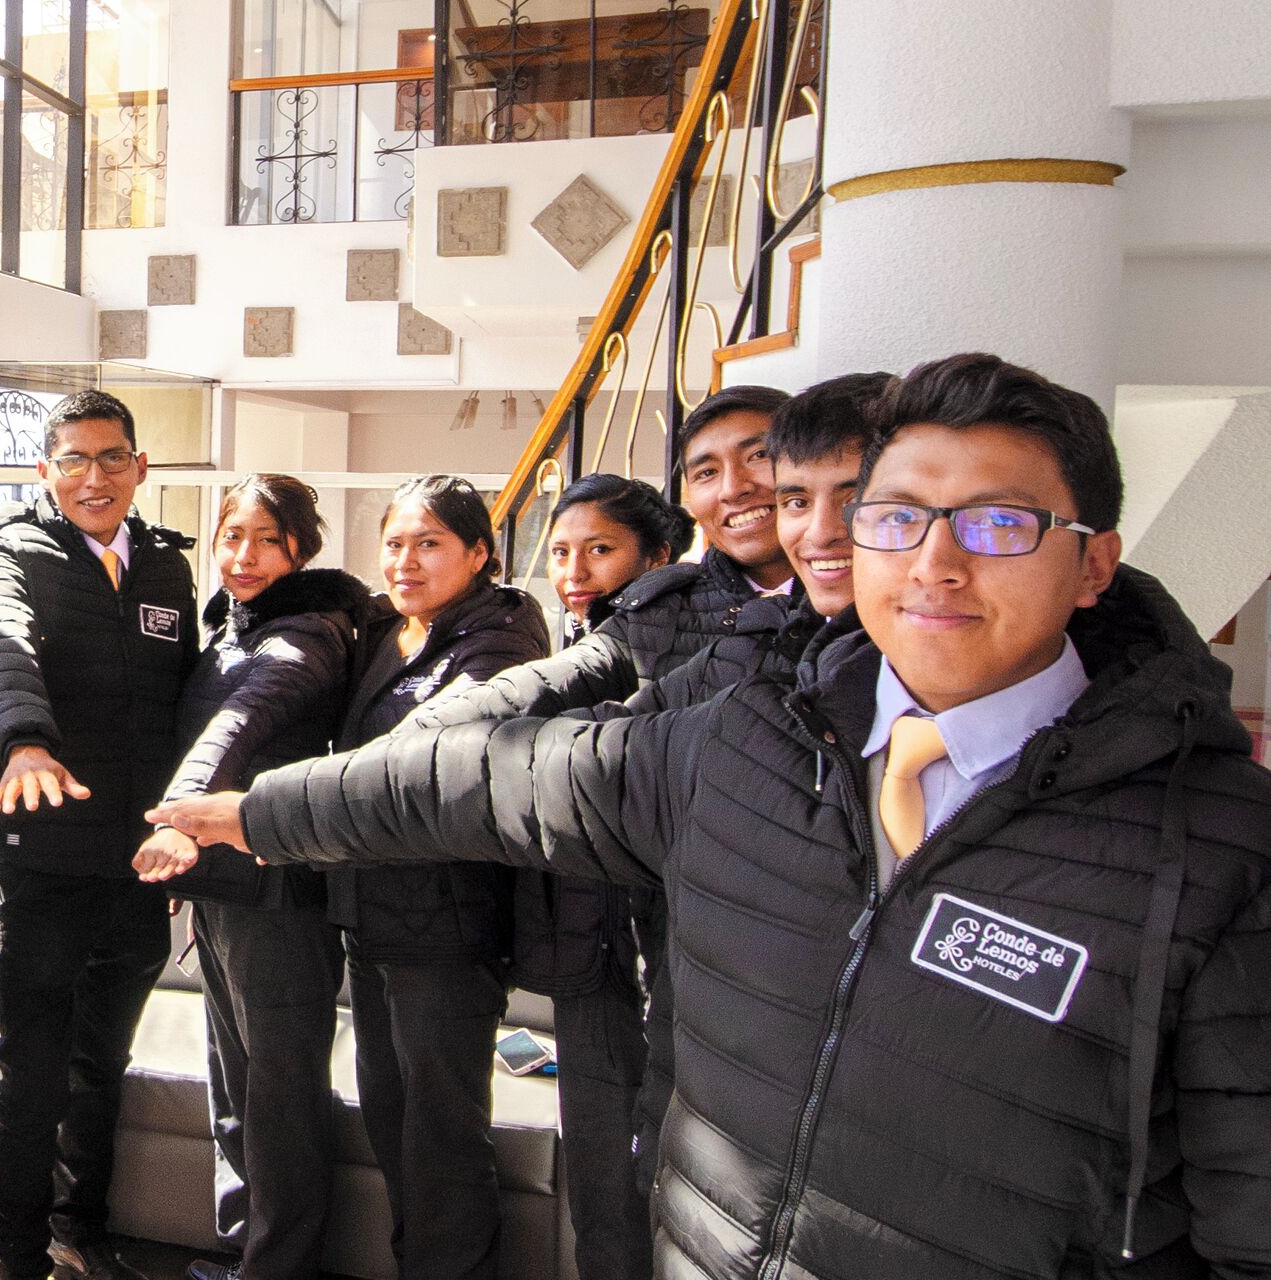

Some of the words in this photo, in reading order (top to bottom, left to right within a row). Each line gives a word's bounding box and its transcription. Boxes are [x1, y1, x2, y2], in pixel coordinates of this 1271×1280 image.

[976, 938, 1039, 974] Lemos
[983, 922, 1037, 956] Conde
[1040, 946, 1066, 968] de
[972, 955, 1020, 981] HOTELES
